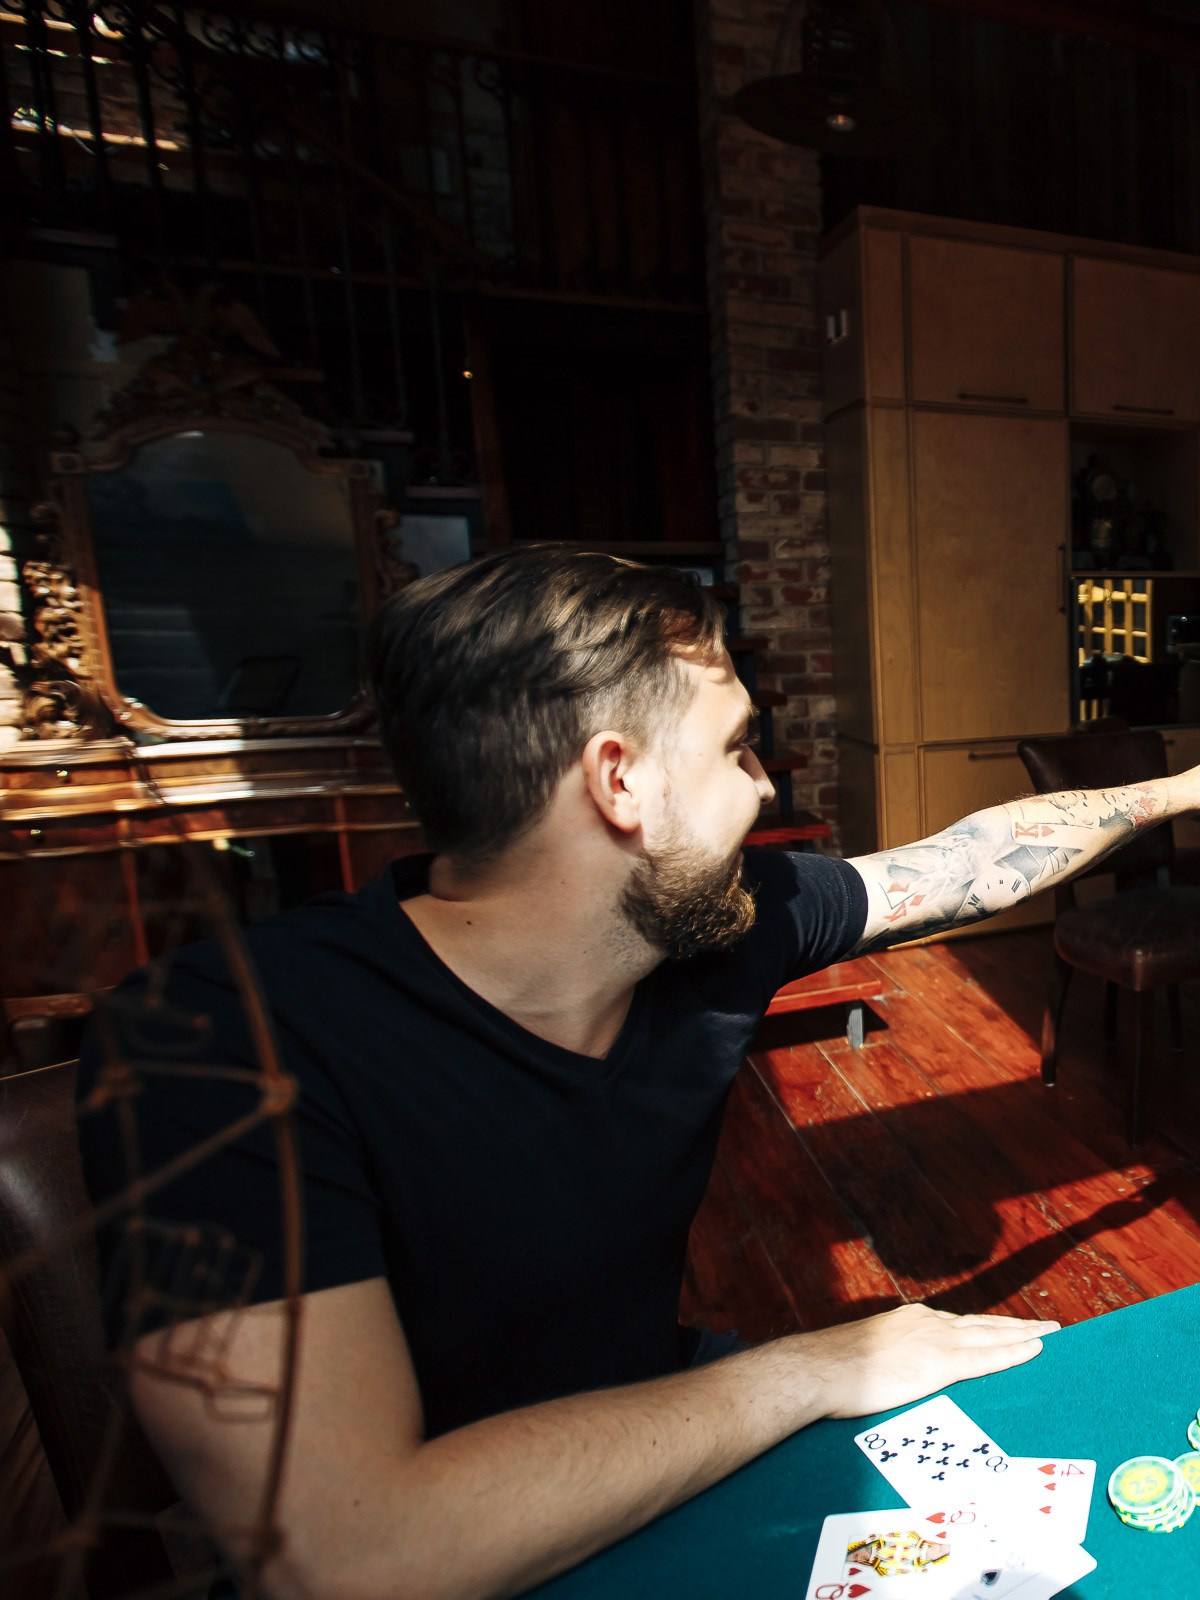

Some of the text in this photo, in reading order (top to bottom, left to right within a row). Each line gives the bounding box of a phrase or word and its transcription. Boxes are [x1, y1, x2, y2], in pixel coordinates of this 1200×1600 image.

[1014, 821, 1039, 838] K
[864, 1433, 887, 1450] 8
[985, 1456, 1008, 1473] 8
[1060, 1463, 1085, 1477] 4
[1129, 1473, 1158, 1496] 25
[946, 1510, 976, 1526] Q
[815, 1582, 849, 1600] Q
